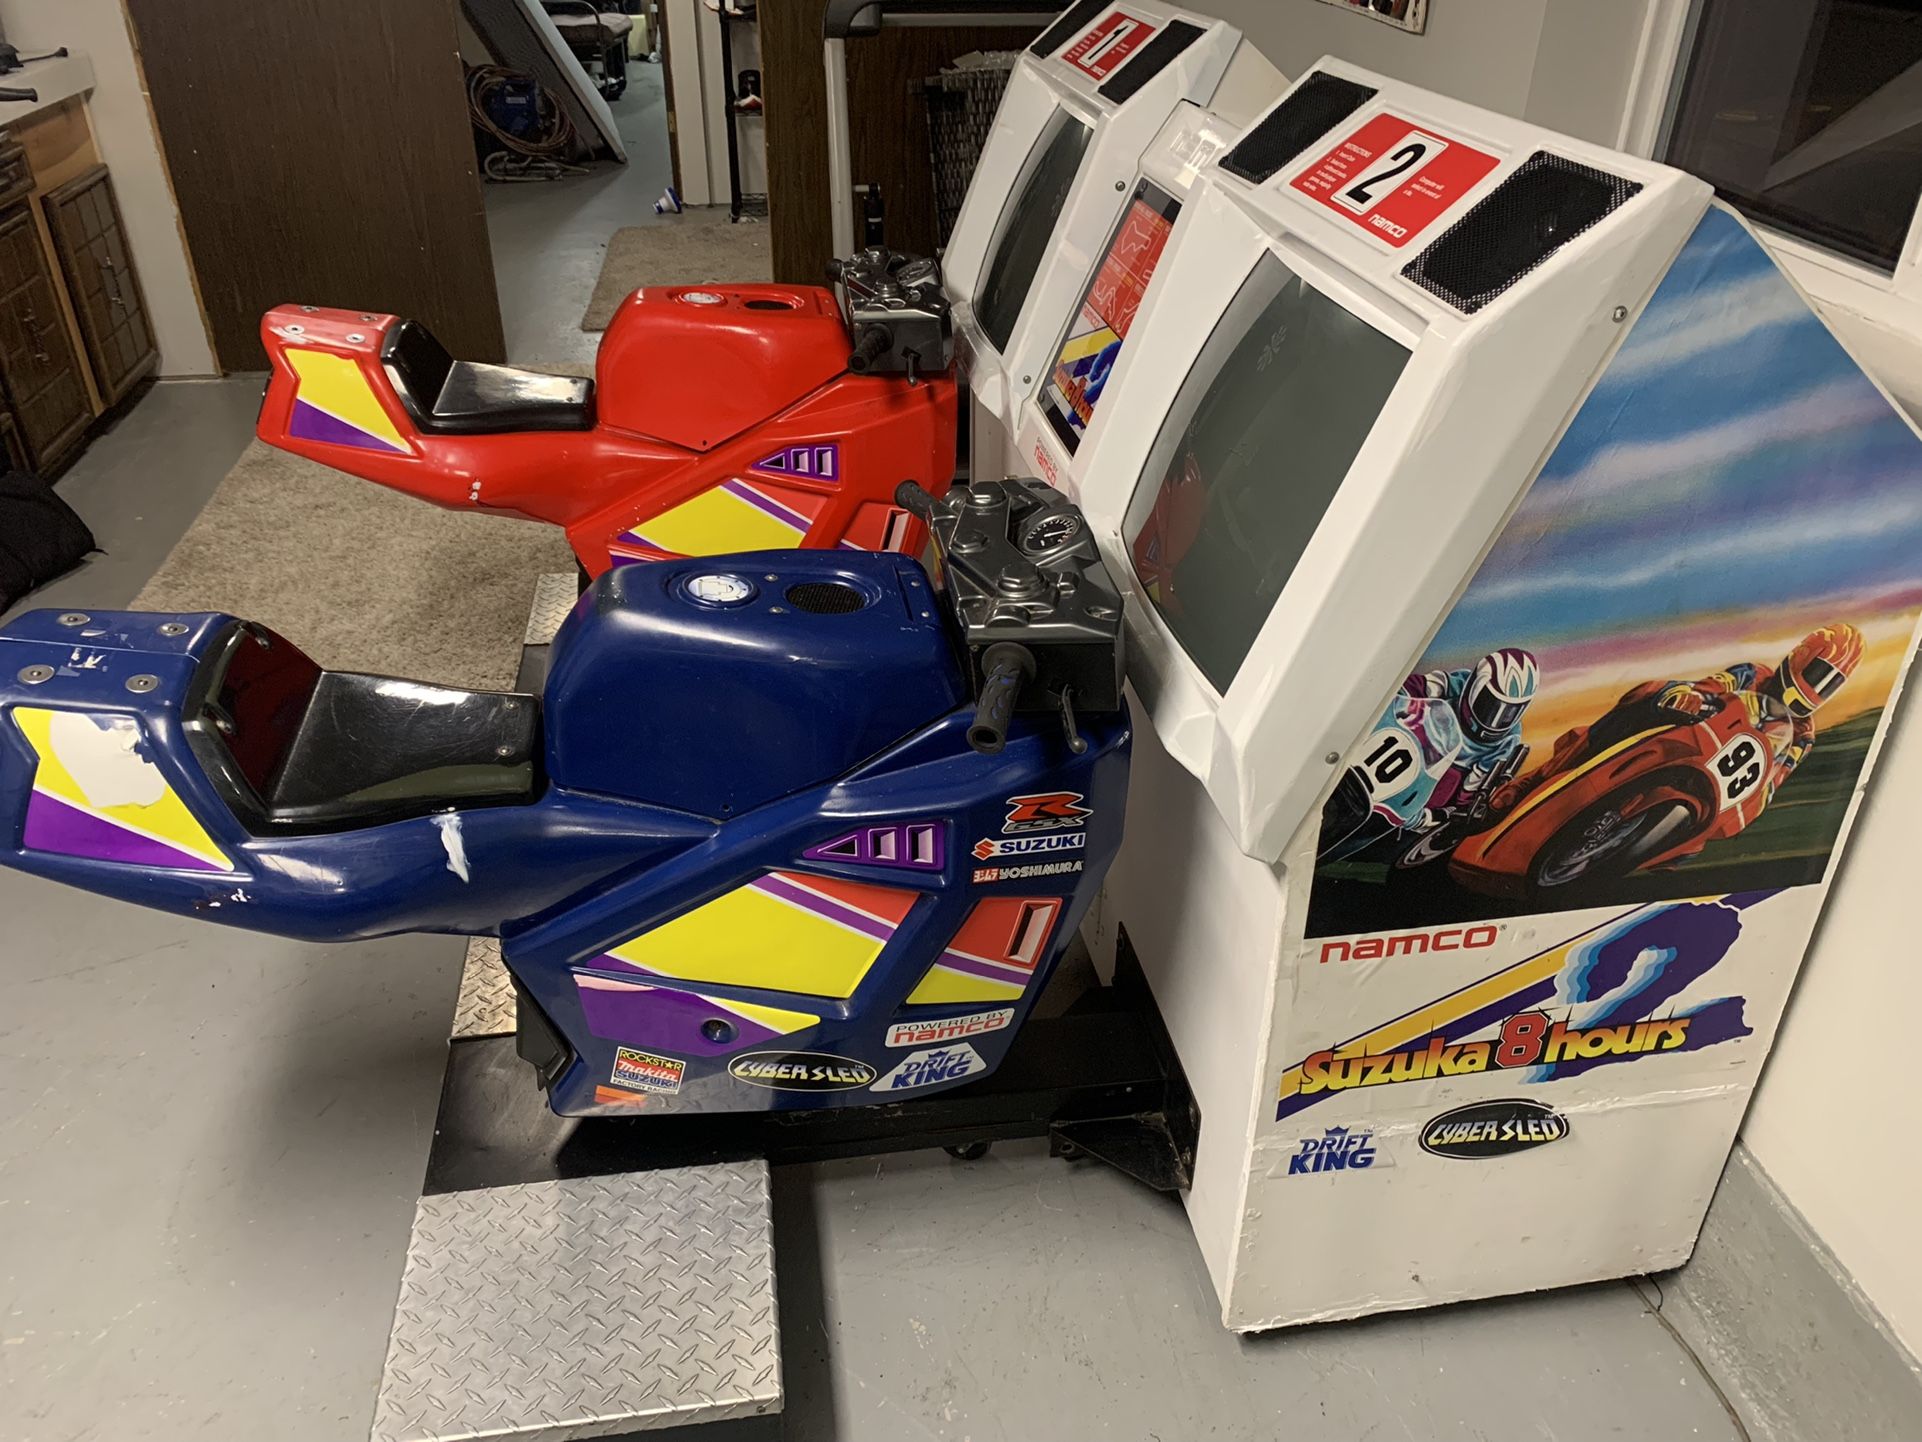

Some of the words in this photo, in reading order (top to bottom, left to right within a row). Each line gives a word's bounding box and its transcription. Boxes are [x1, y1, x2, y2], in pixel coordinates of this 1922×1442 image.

[1088, 25, 1128, 60] 1
[1345, 143, 1426, 205] 2
[1368, 213, 1408, 239] namco
[1363, 736, 1413, 783] 10
[1716, 741, 1760, 799] 93
[1000, 835, 1084, 854] SUZUKI
[999, 860, 1083, 880] YOSHIMURA
[1319, 924, 1498, 964] namco
[893, 1016, 1005, 1044] namco
[896, 1016, 980, 1032] POWERED
[987, 1010, 1008, 1020] BY
[904, 1050, 971, 1073] DRIFT
[1299, 1036, 1490, 1095] Suzuka
[1495, 1012, 1549, 1068] 8
[1543, 1017, 1692, 1063] hours
[618, 1060, 679, 1083] makita
[734, 1060, 808, 1080] CYBER
[811, 1065, 870, 1083] SLED
[891, 1059, 972, 1089] KING
[1300, 1133, 1373, 1153] DRIFT
[1428, 1120, 1498, 1146] CYBER
[1499, 1115, 1560, 1141] SLED
[1288, 1148, 1376, 1175] KING
